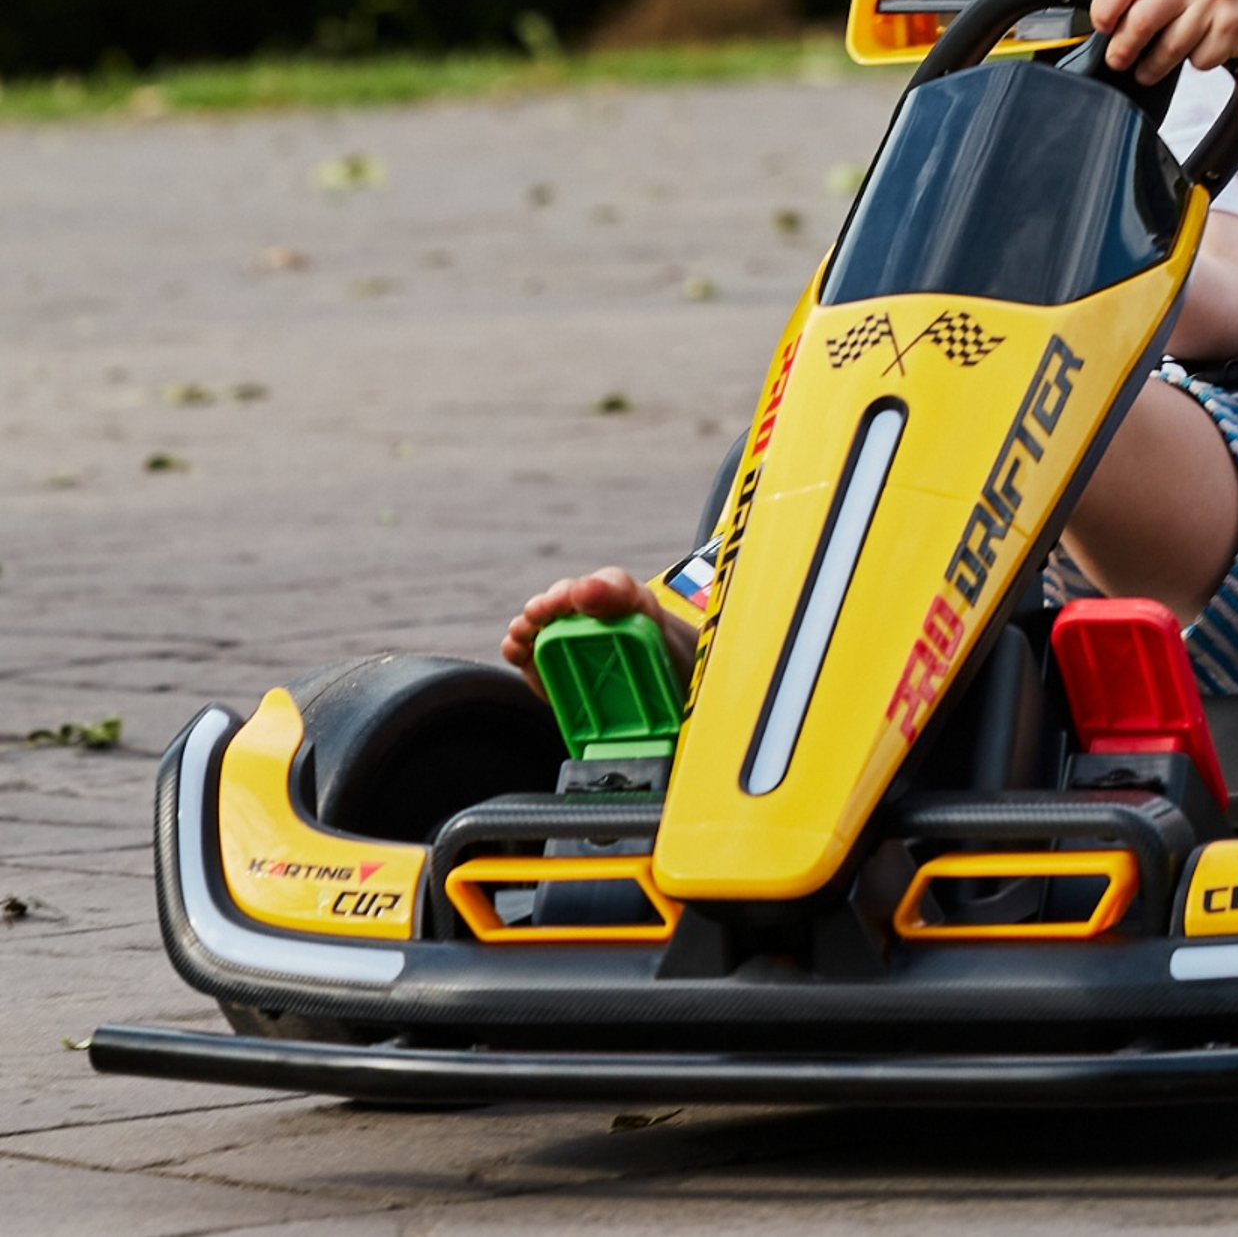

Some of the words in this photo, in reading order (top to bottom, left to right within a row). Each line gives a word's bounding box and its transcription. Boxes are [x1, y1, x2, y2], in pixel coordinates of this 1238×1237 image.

[886, 594, 965, 746] PRO
[944, 333, 1085, 608] DRIFTER
[331, 891, 402, 919] CUP
